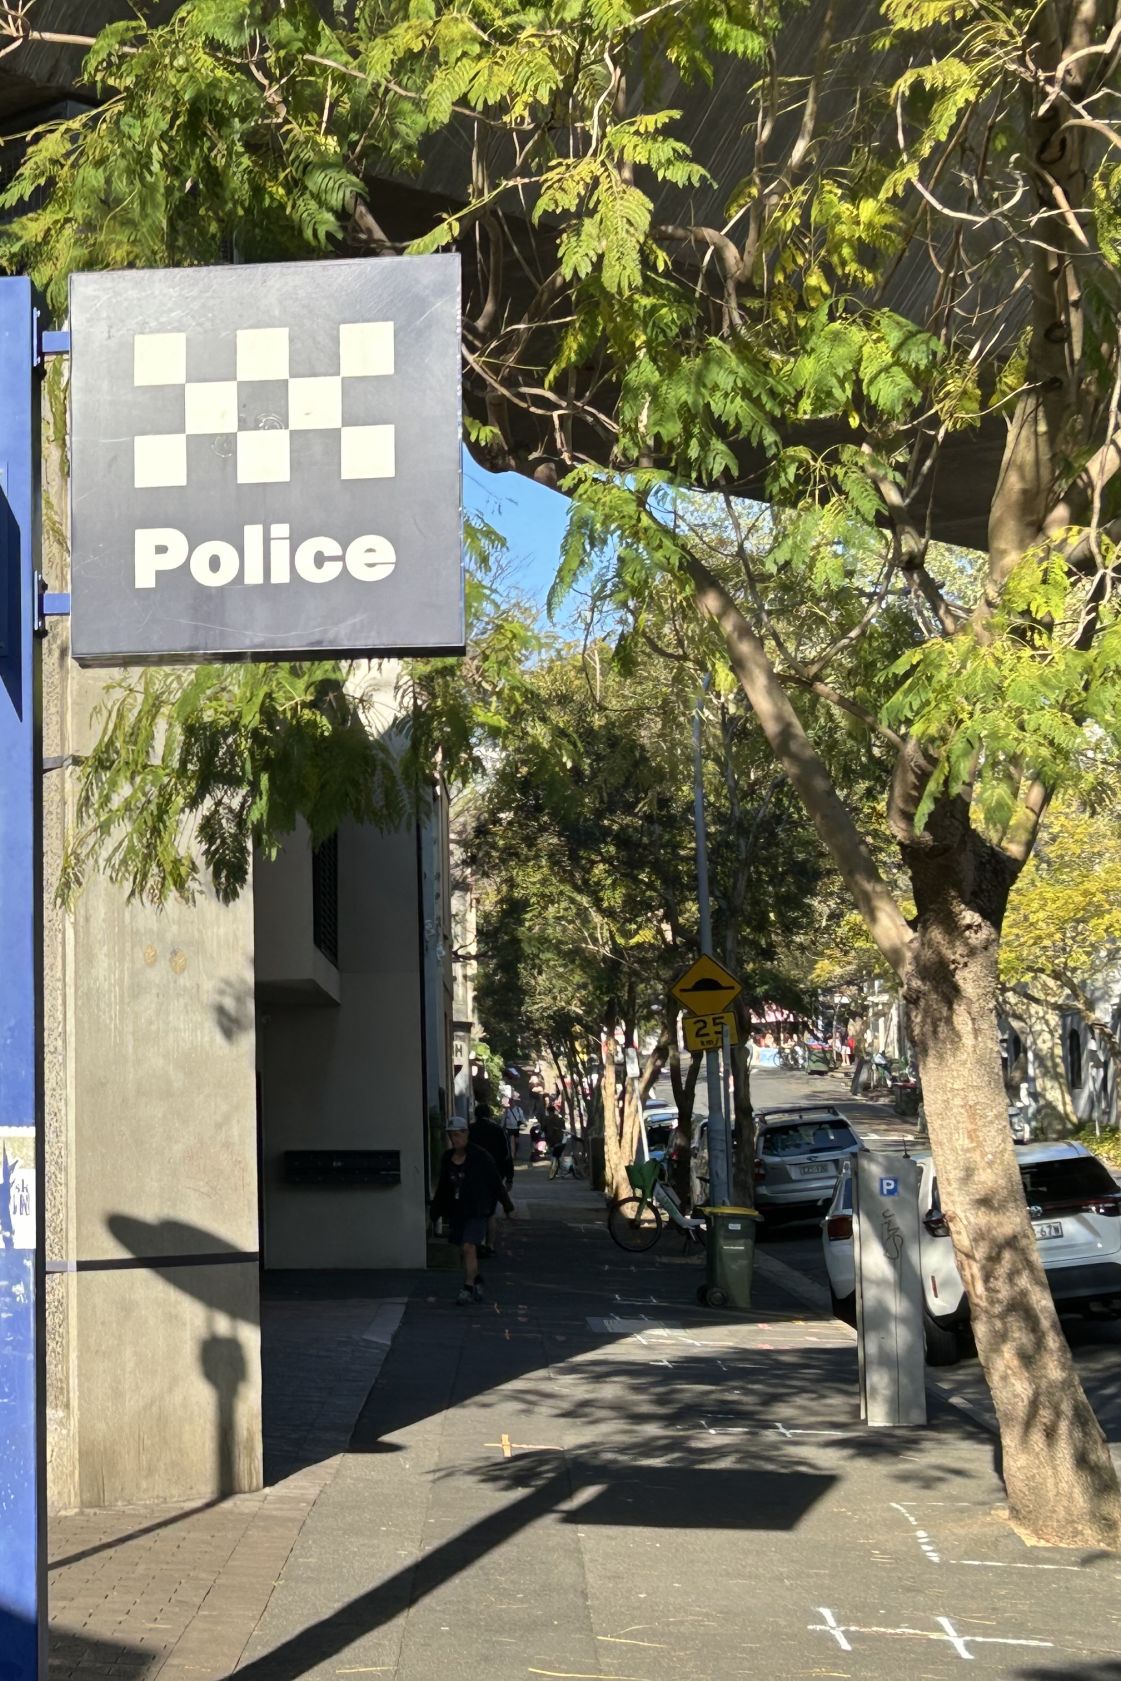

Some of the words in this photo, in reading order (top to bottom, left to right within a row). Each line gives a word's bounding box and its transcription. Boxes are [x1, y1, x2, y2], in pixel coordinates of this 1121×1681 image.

[134, 523, 396, 589] Police
[693, 1015, 728, 1038] 25
[882, 1179, 895, 1195] P
